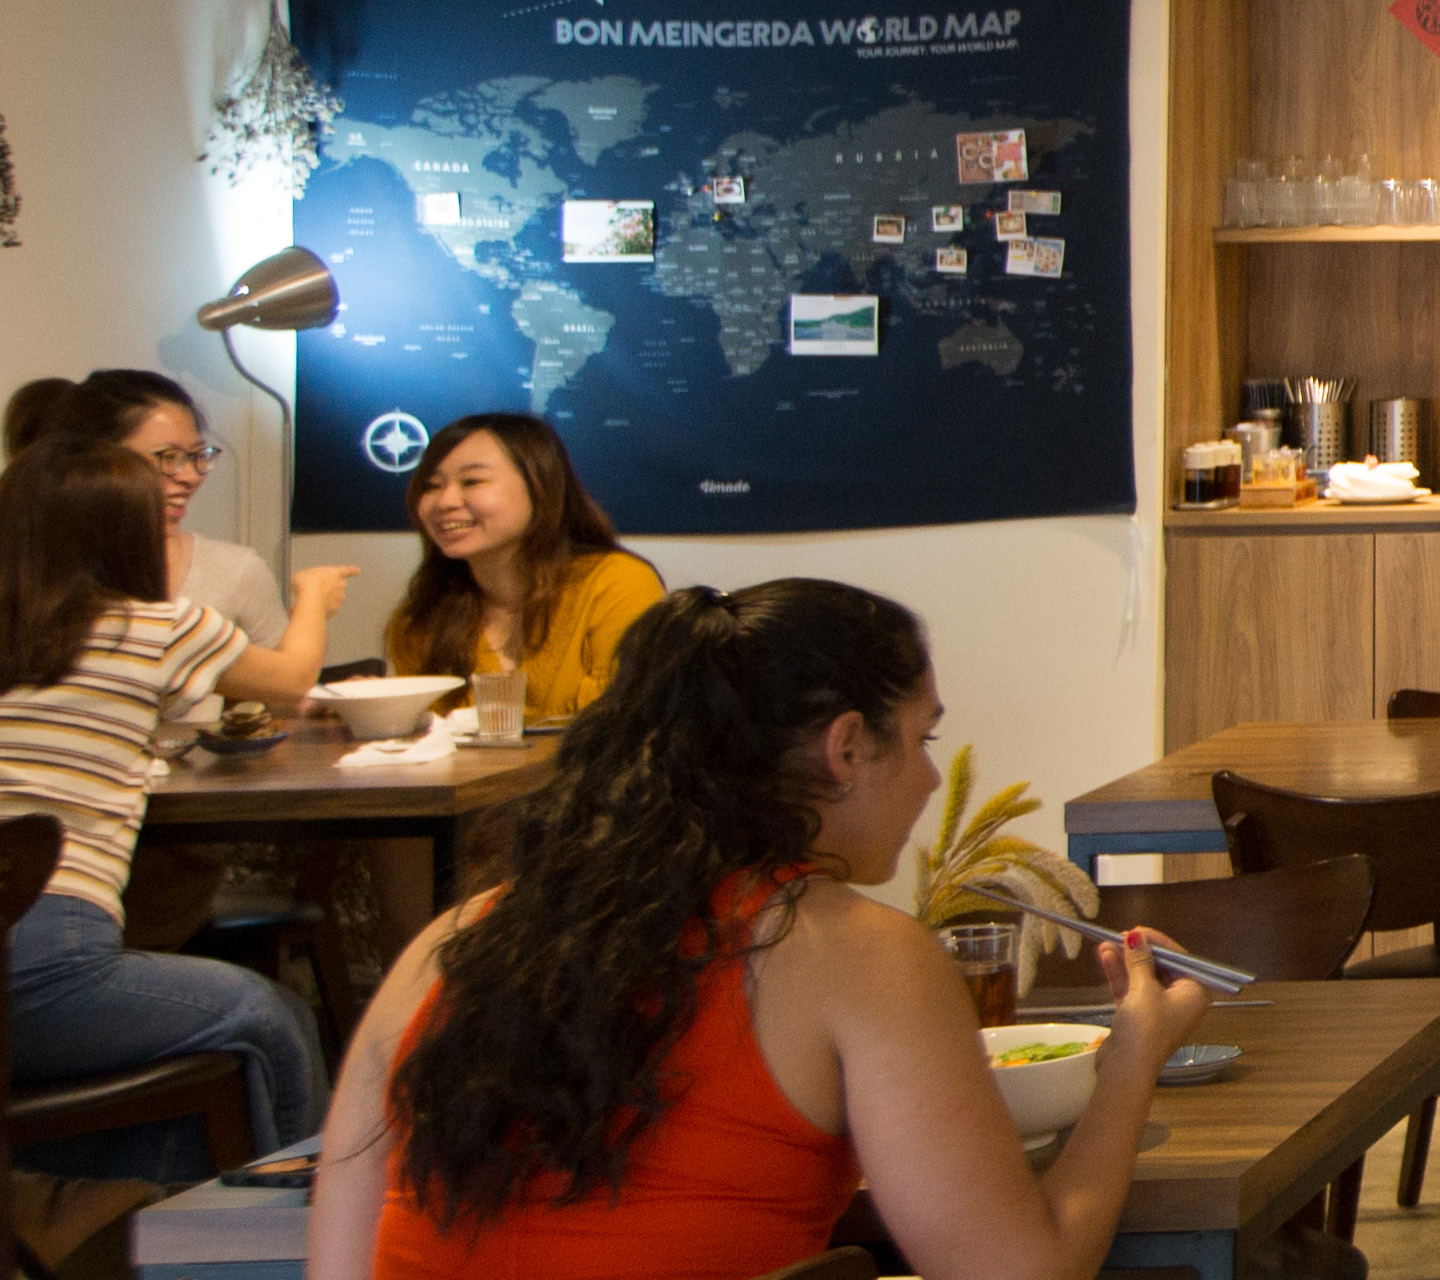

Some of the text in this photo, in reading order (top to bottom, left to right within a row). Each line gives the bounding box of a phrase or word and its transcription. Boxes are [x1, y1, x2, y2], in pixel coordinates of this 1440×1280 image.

[556, 18, 623, 47] BON
[628, 19, 815, 48] MEINGERDA
[943, 10, 1021, 40] MAP
[413, 160, 470, 173] CANADA
